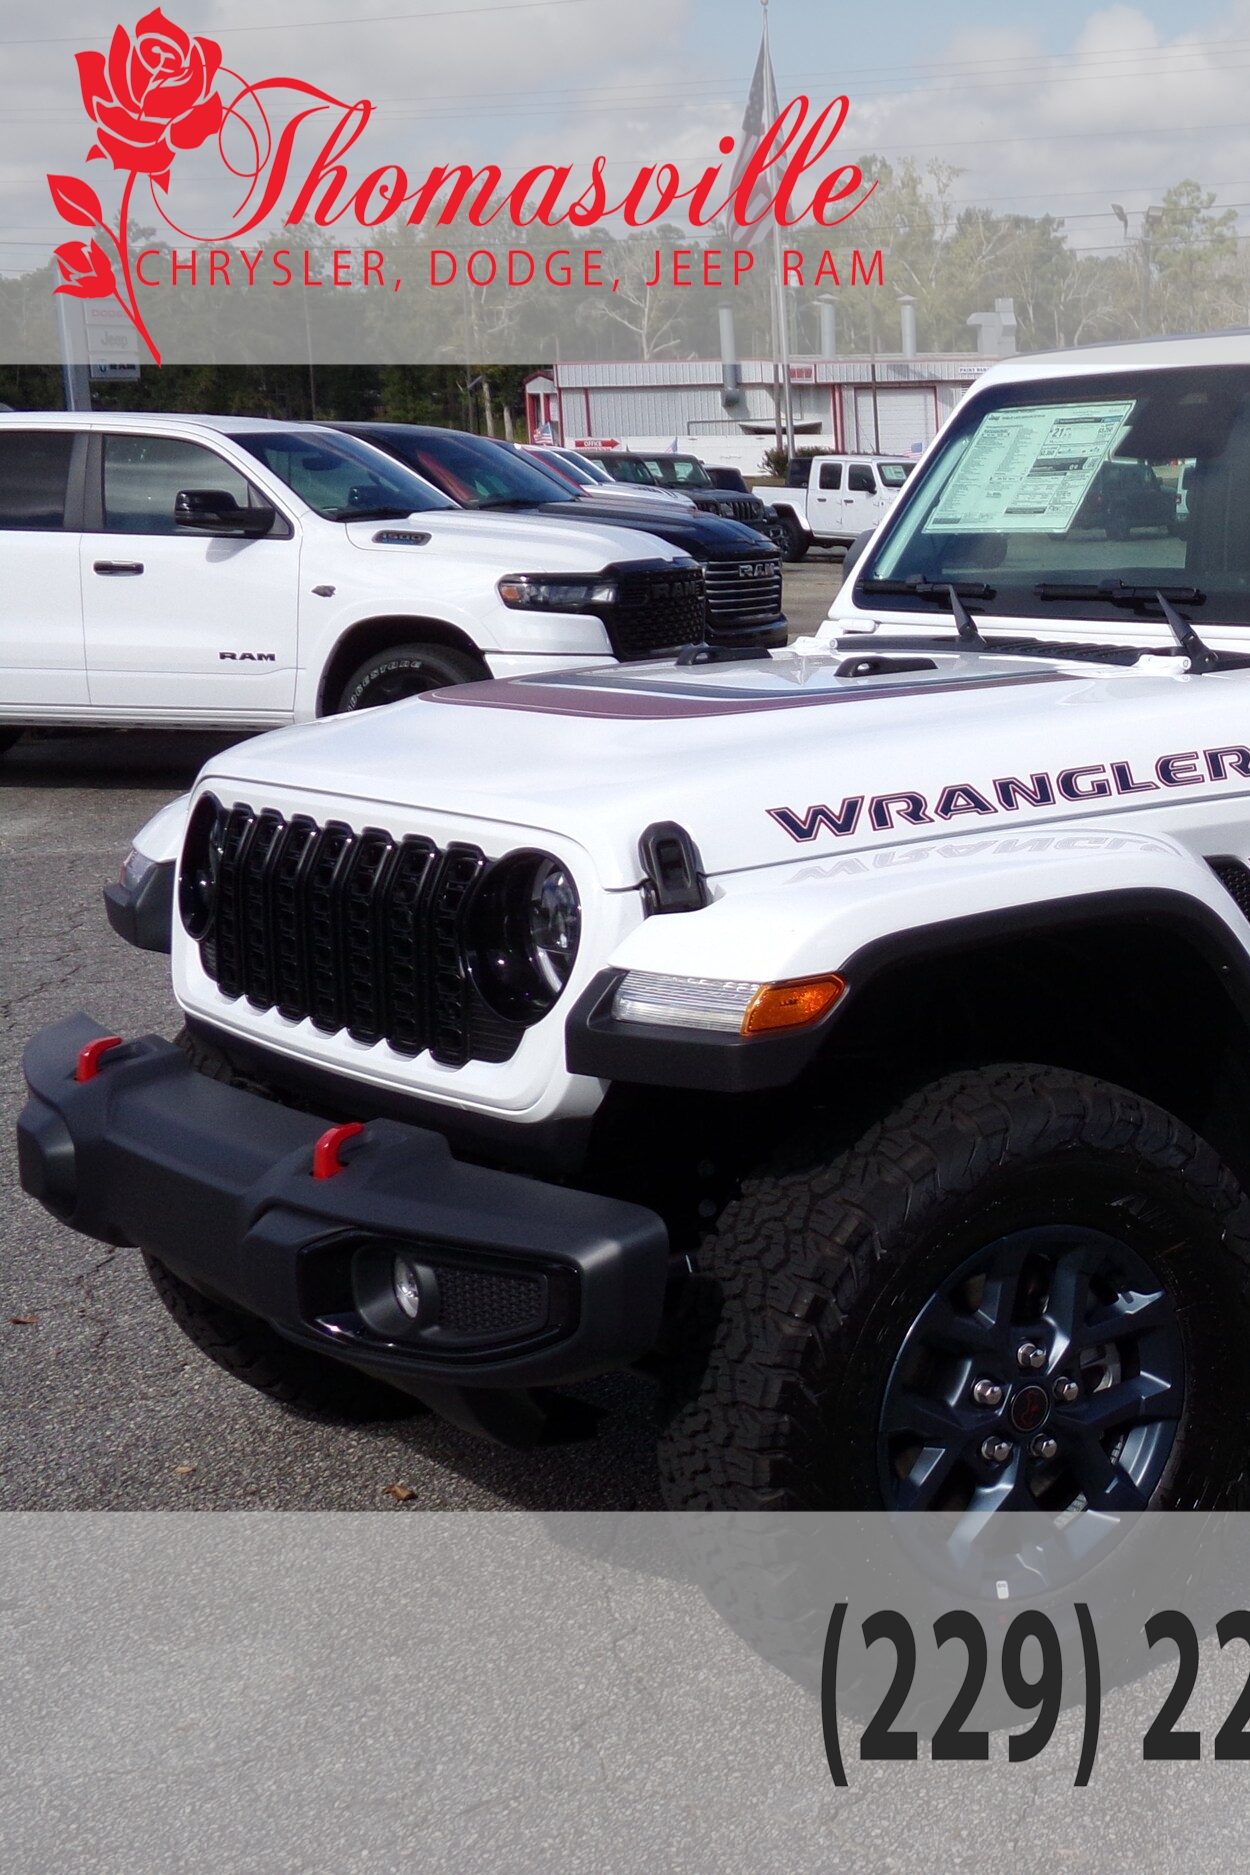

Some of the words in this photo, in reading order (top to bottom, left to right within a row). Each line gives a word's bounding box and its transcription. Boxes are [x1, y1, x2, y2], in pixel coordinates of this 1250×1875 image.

[101, 330, 128, 349] Jeep
[738, 562, 776, 577] RAM
[651, 580, 696, 599] RAM
[219, 651, 276, 662] RAM
